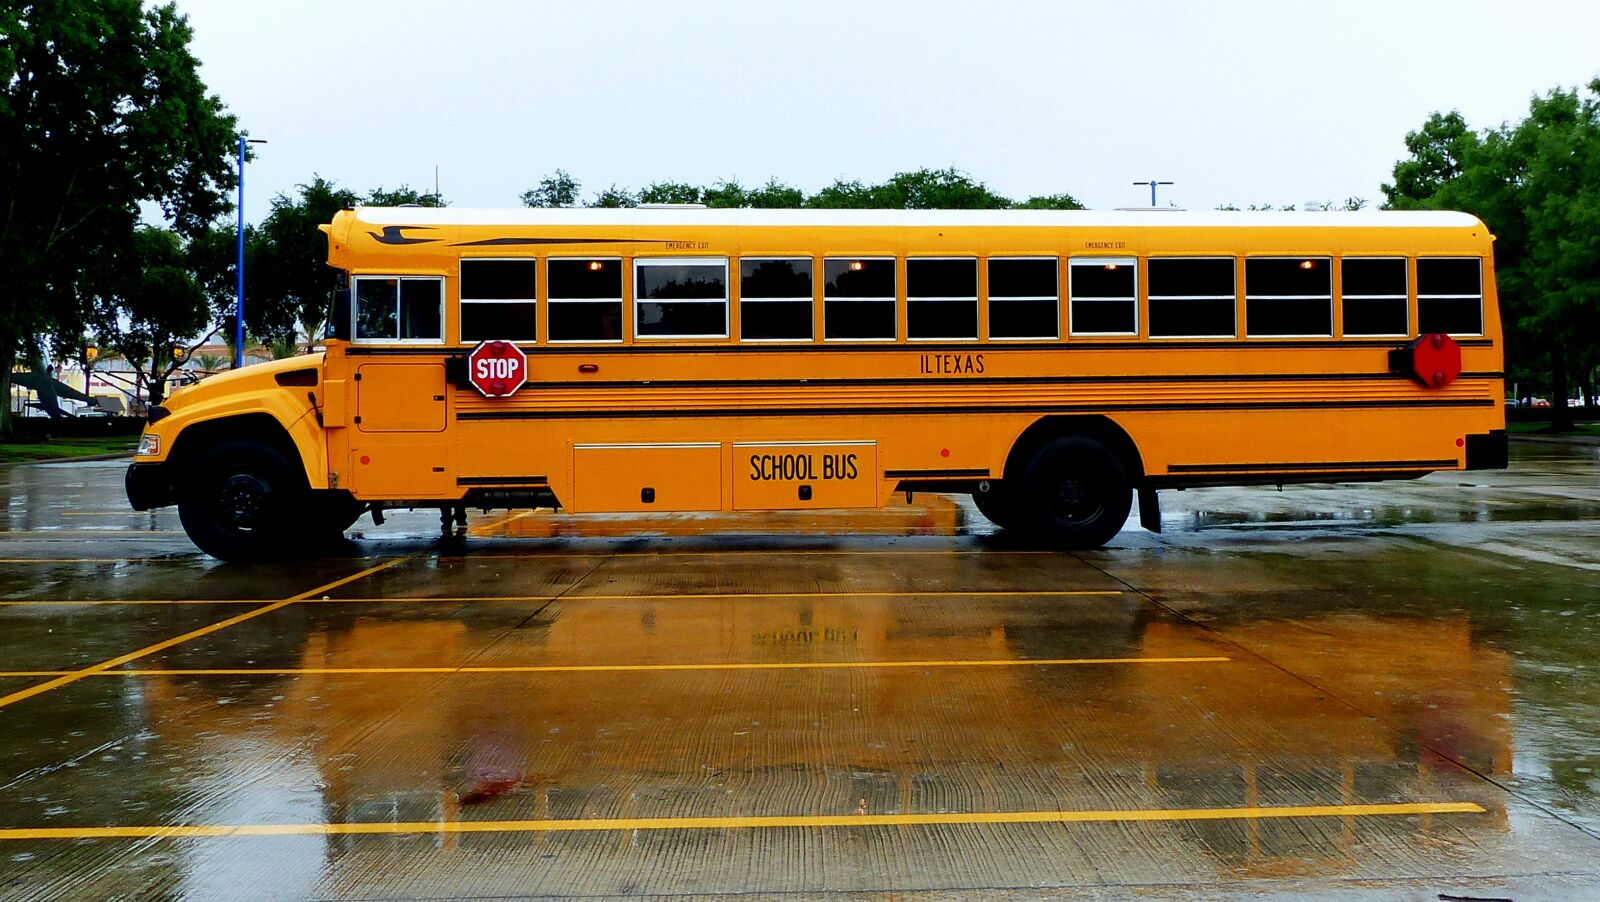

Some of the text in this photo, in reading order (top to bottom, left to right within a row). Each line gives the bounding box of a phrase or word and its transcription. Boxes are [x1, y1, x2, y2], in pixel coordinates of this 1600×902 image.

[665, 241, 709, 249] EMERGENCY EXIT
[1085, 241, 1126, 249] EMERGENCY EXIT
[476, 358, 519, 379] STOP
[920, 354, 985, 374] ILTEXAS
[750, 453, 858, 481] SCHOOL BUS
